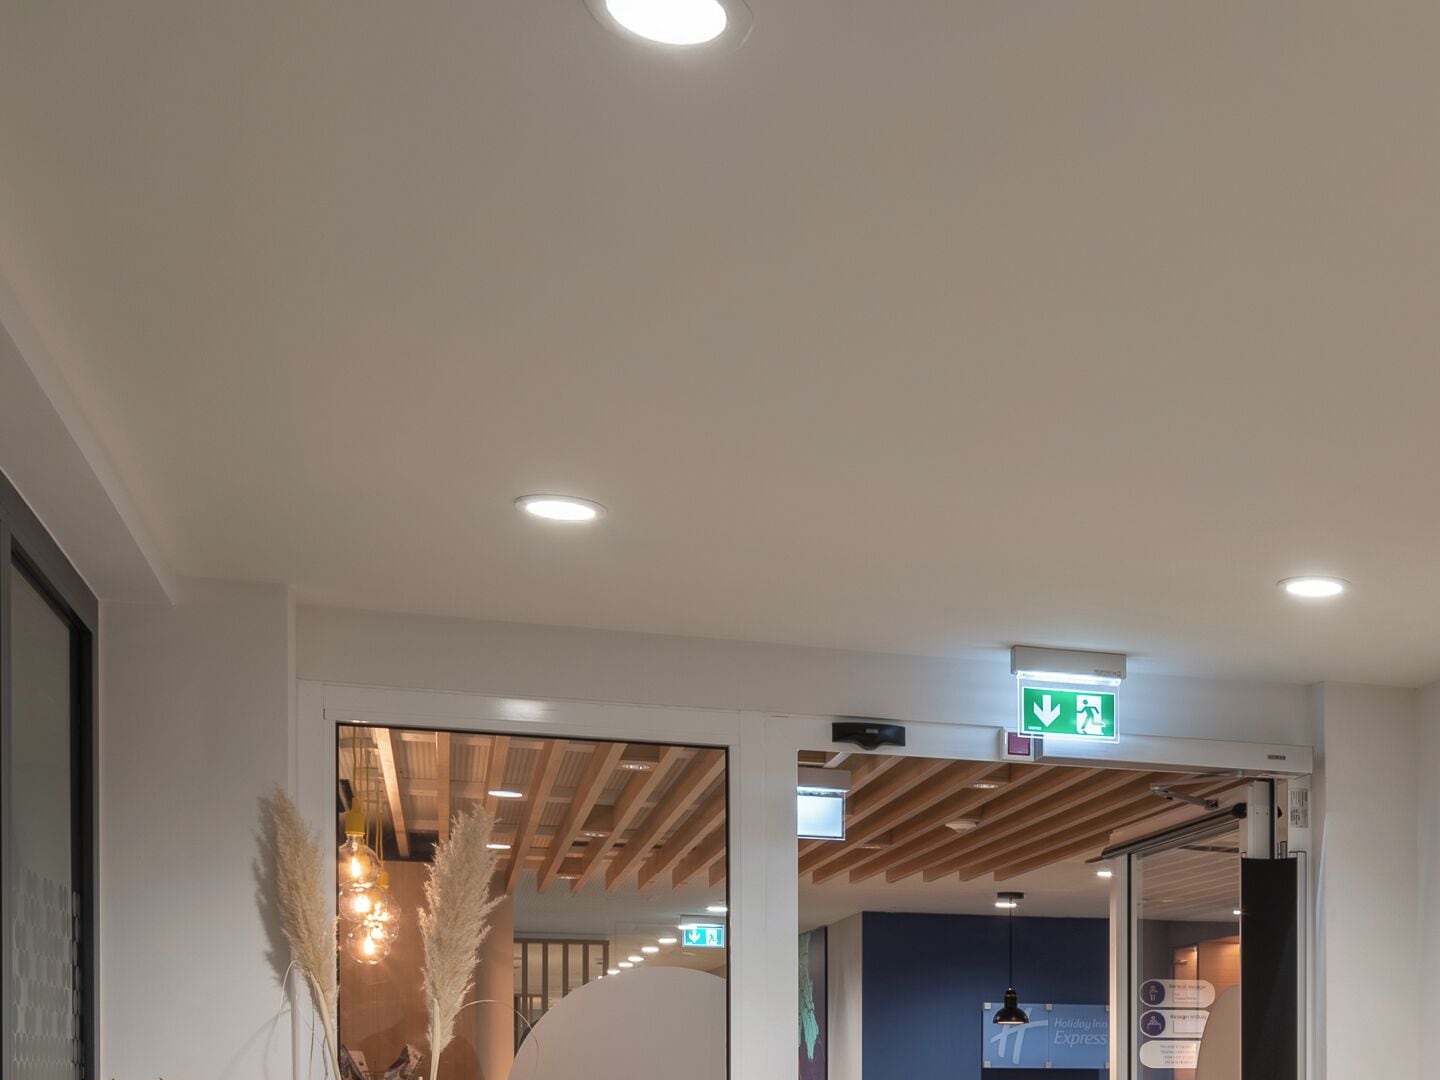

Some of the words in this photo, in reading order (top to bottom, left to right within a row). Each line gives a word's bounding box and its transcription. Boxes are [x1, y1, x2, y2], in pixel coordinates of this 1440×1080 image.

[1054, 1017, 1091, 1030] Holiday
[1092, 1018, 1108, 1029] Inn
[1054, 1030, 1108, 1048] Express
